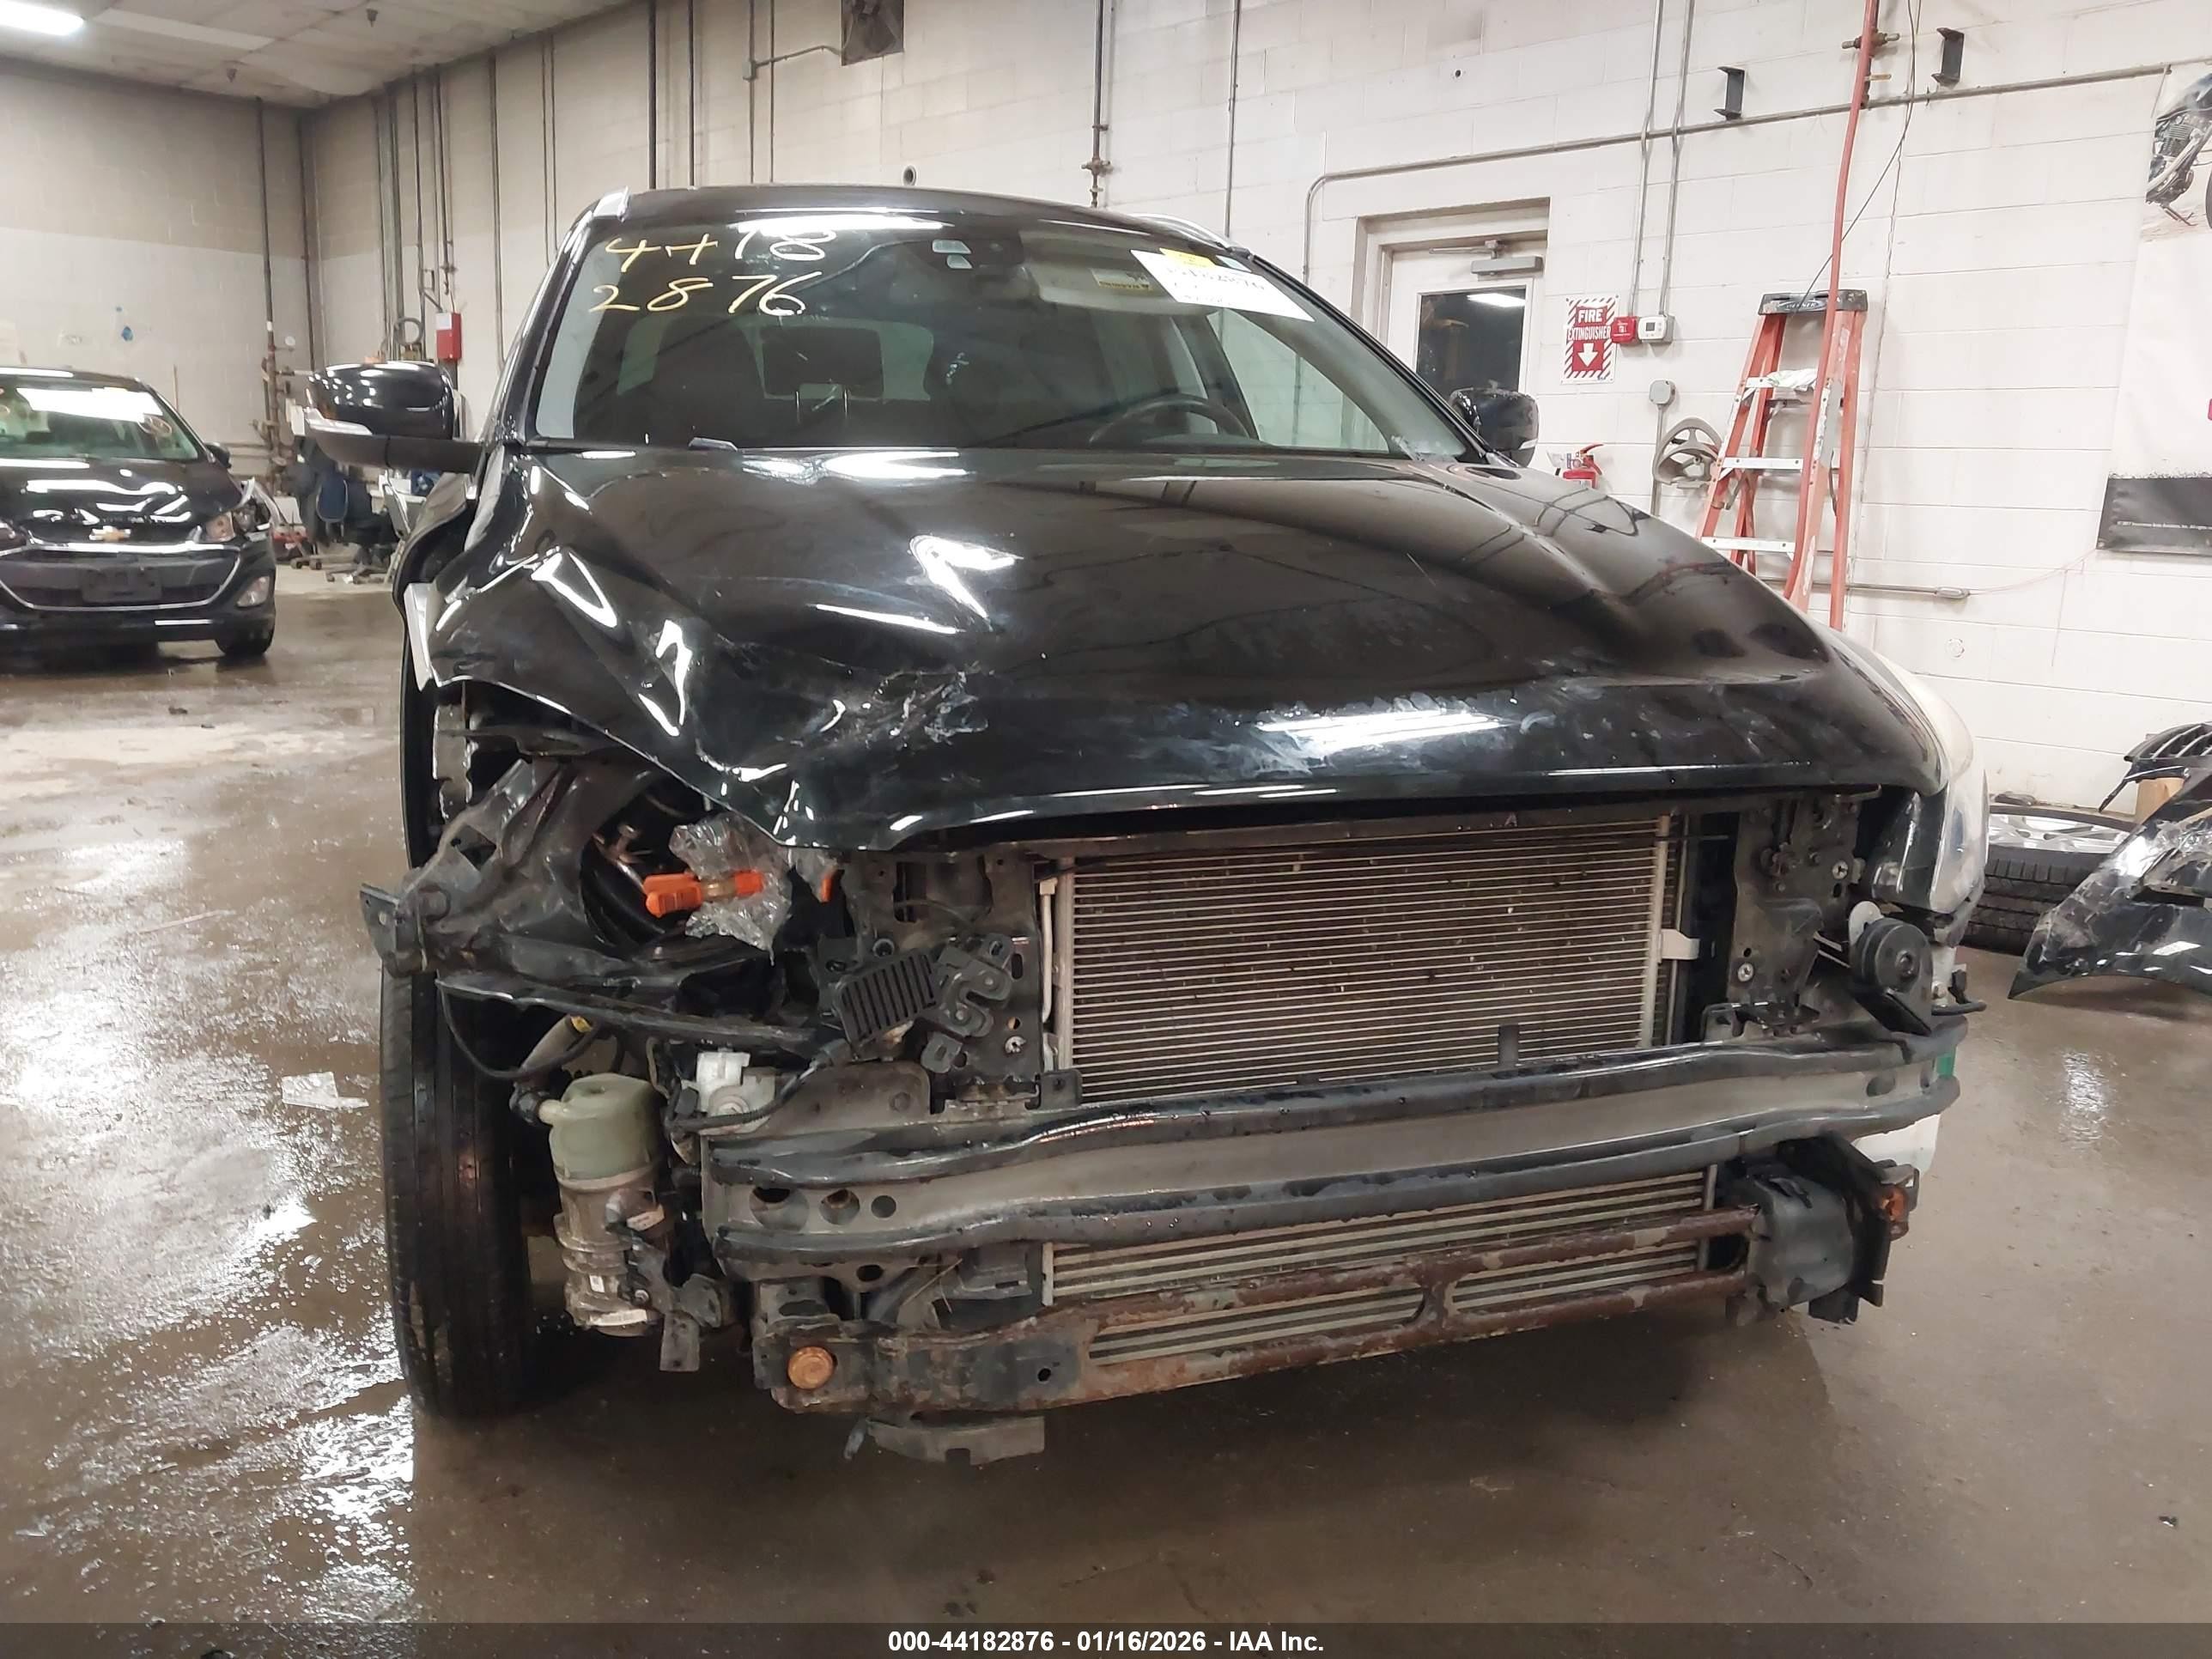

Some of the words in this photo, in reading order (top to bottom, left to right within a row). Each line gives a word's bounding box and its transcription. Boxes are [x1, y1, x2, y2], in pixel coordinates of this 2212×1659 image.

[589, 270, 823, 316] 2876
[1577, 309, 1604, 324] FIRE
[1567, 325, 1612, 341] EXTINGUISHER
